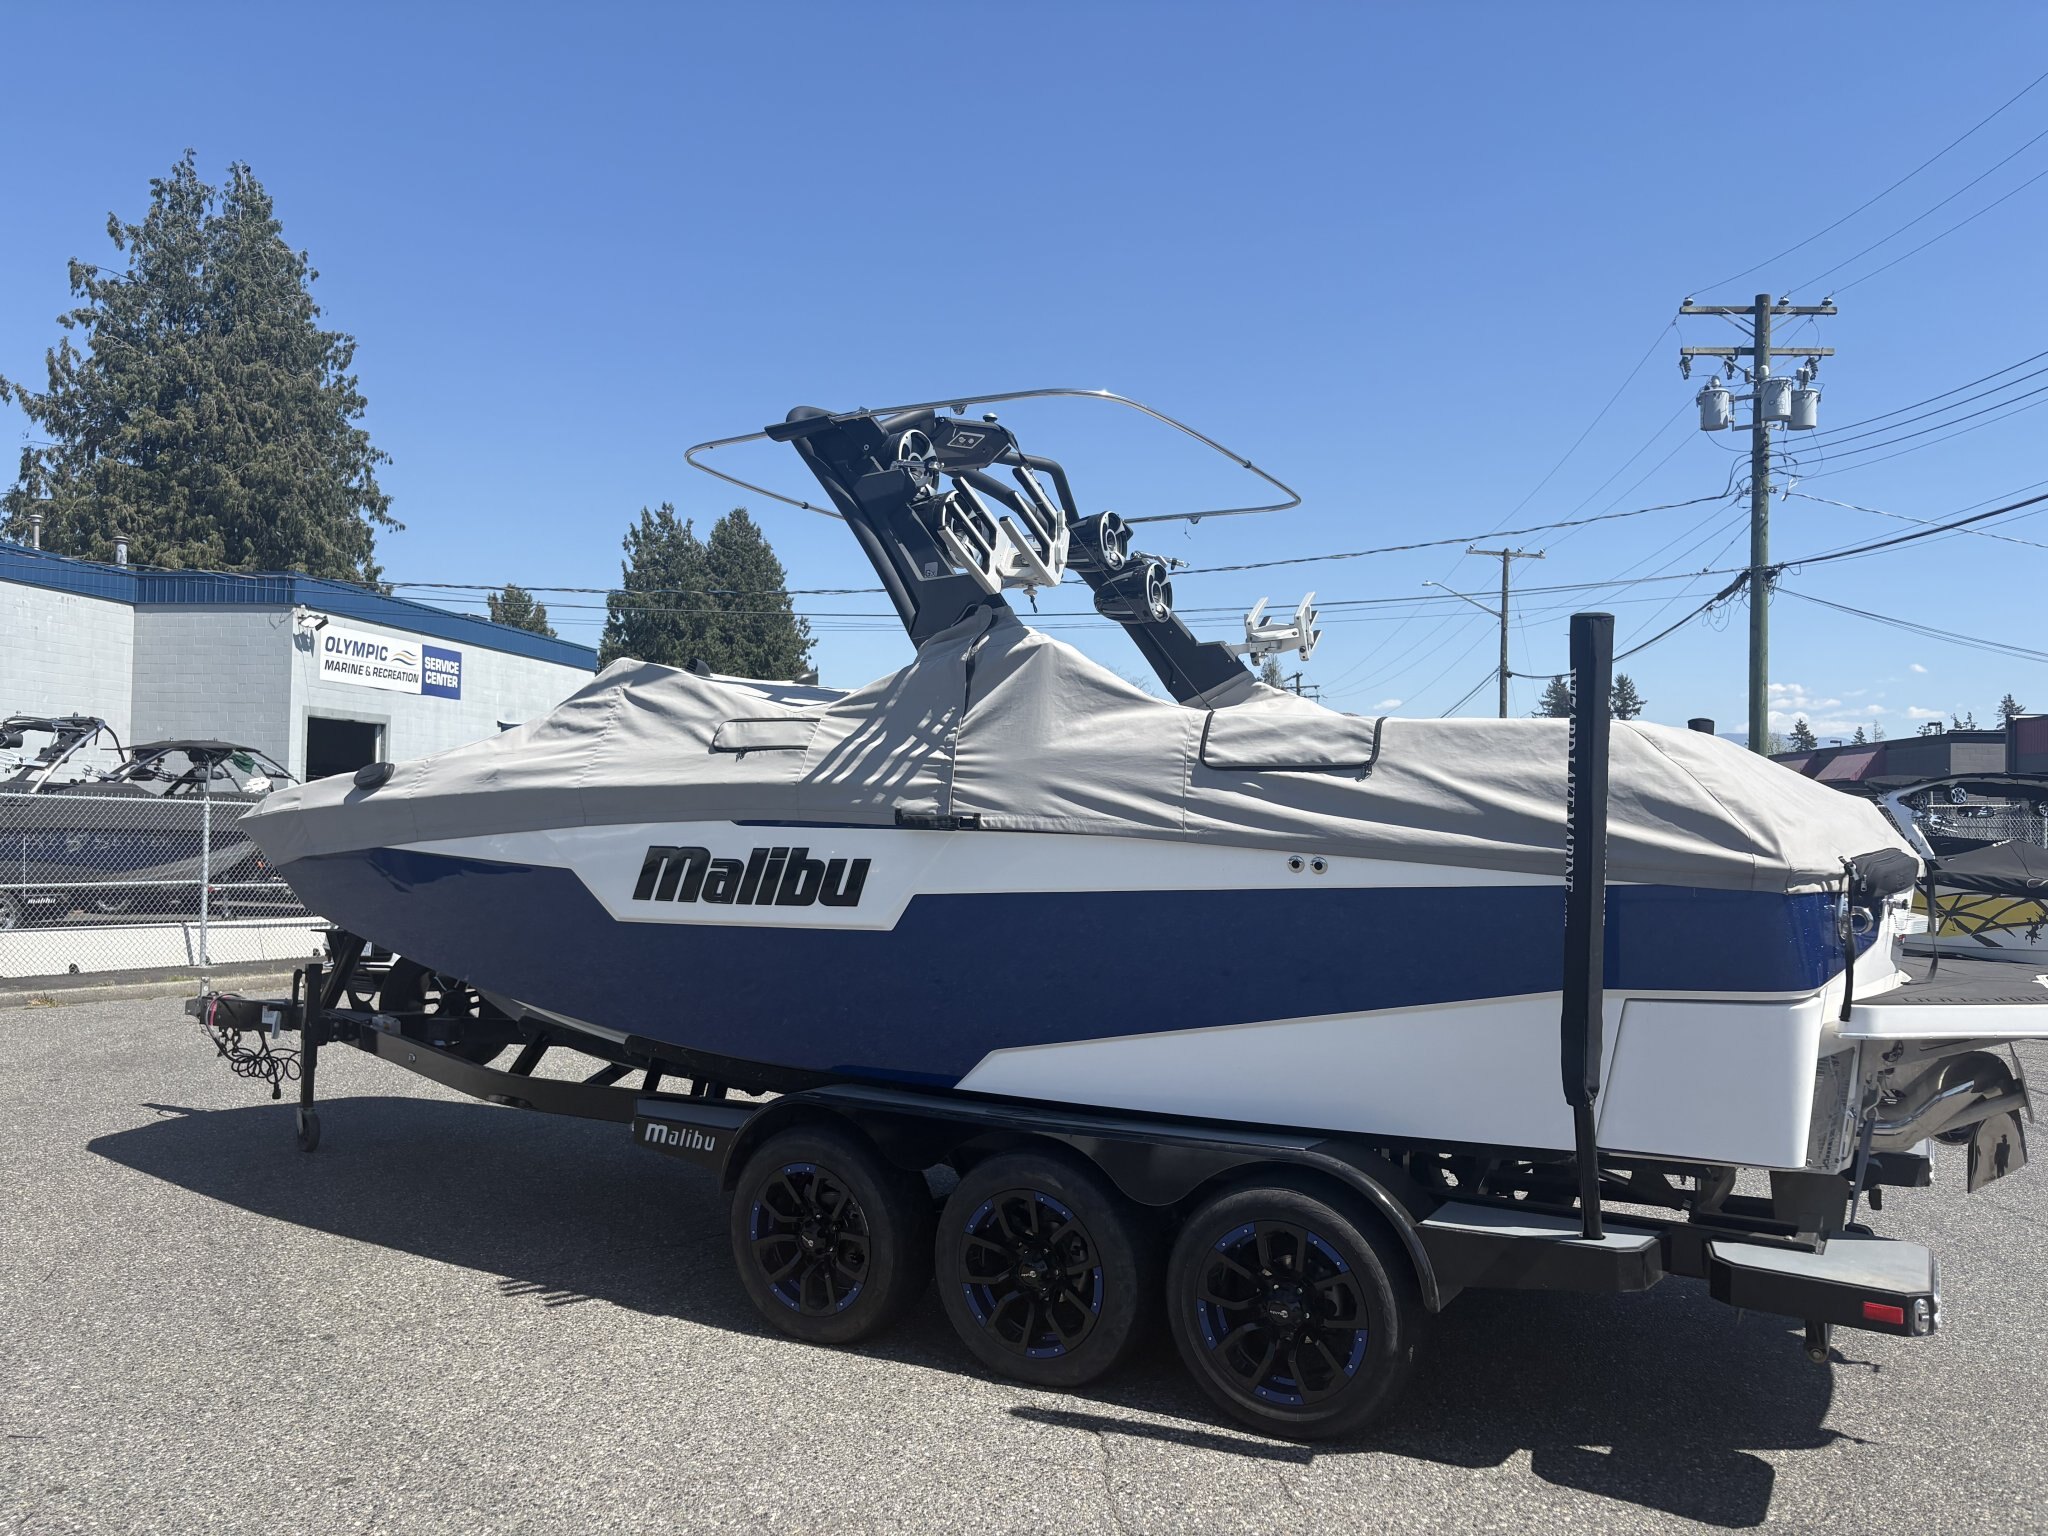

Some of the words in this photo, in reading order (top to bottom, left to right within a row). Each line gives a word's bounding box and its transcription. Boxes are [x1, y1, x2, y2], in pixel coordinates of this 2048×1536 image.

[325, 636, 388, 661] OLYMPIC
[324, 659, 364, 676] MARINE
[365, 667, 371, 676] &
[372, 667, 419, 683] RECREATION
[424, 656, 460, 675] SERVICE
[425, 670, 458, 688] CENTER
[632, 845, 872, 907] Malibu
[645, 1123, 716, 1152] Malibu
